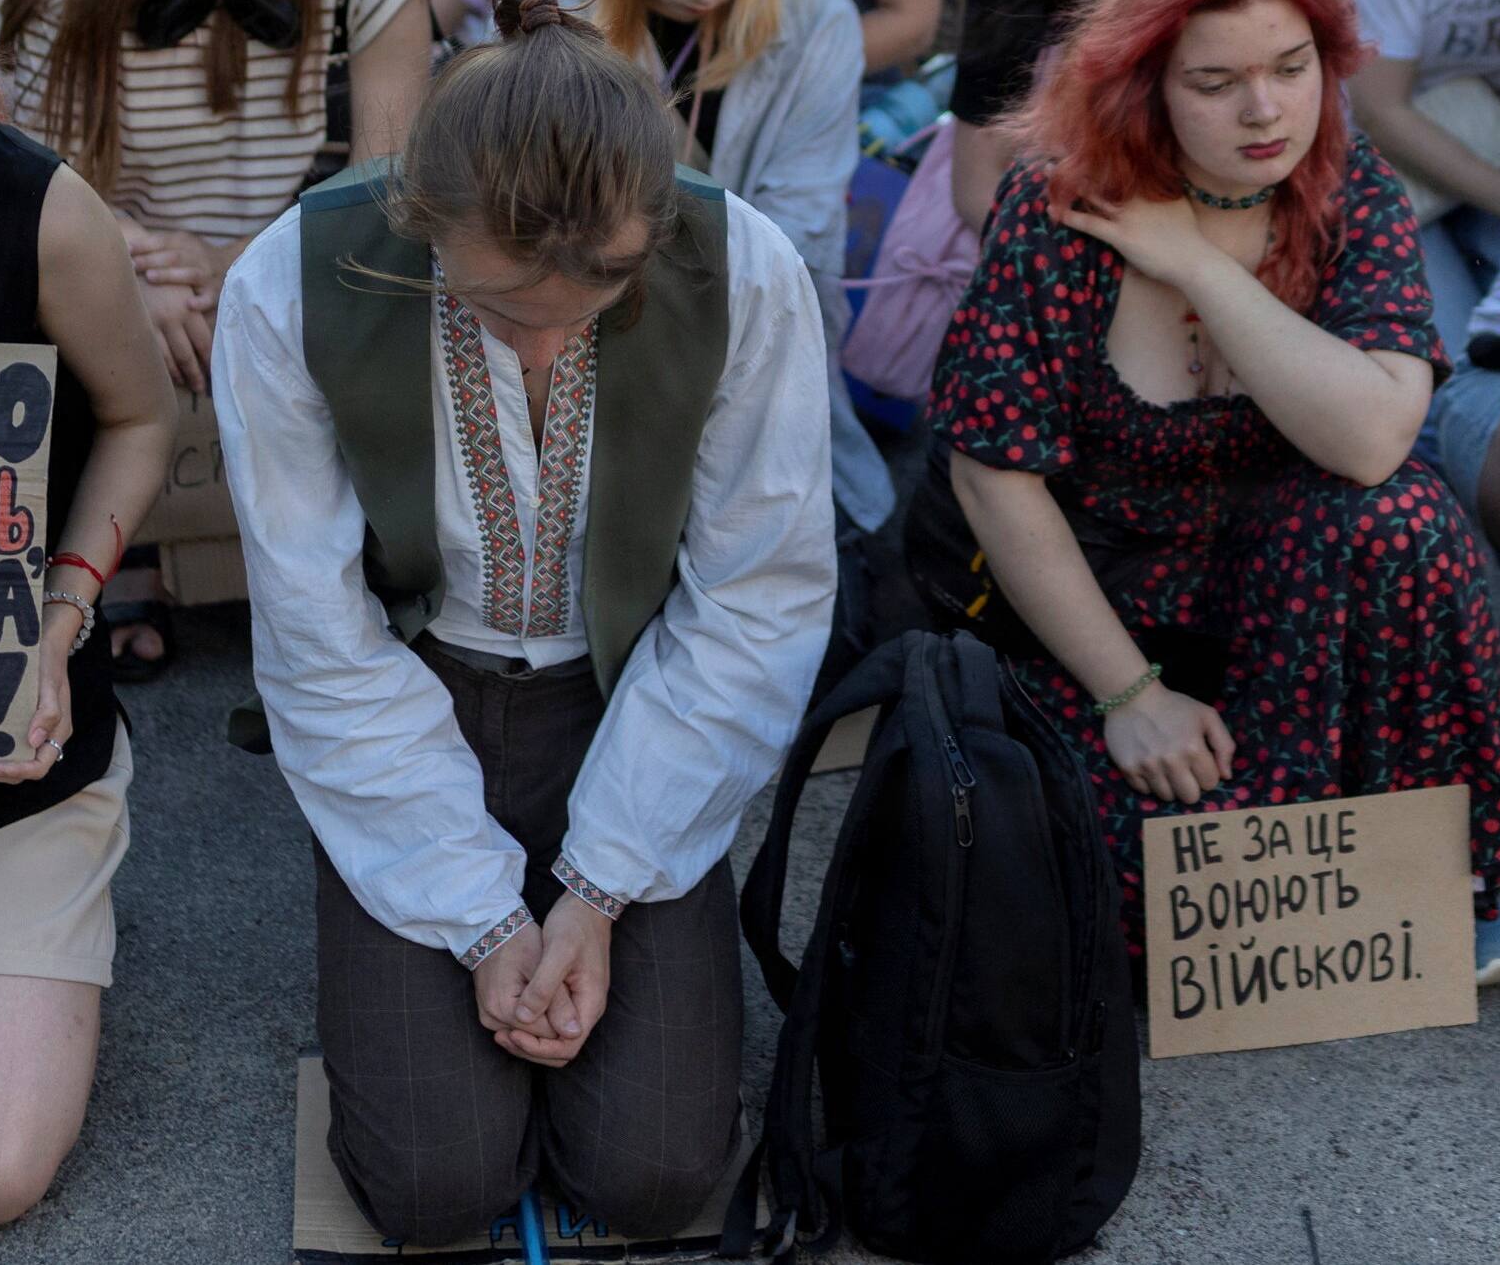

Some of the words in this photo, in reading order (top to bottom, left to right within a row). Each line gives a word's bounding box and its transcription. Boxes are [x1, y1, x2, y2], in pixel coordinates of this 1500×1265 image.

[1171, 821, 1224, 875] НЕ
[1242, 814, 1294, 863] ЗА
[1305, 809, 1357, 863] ЦЕ
[1169, 868, 1361, 942] ВОЮЮТЬ
